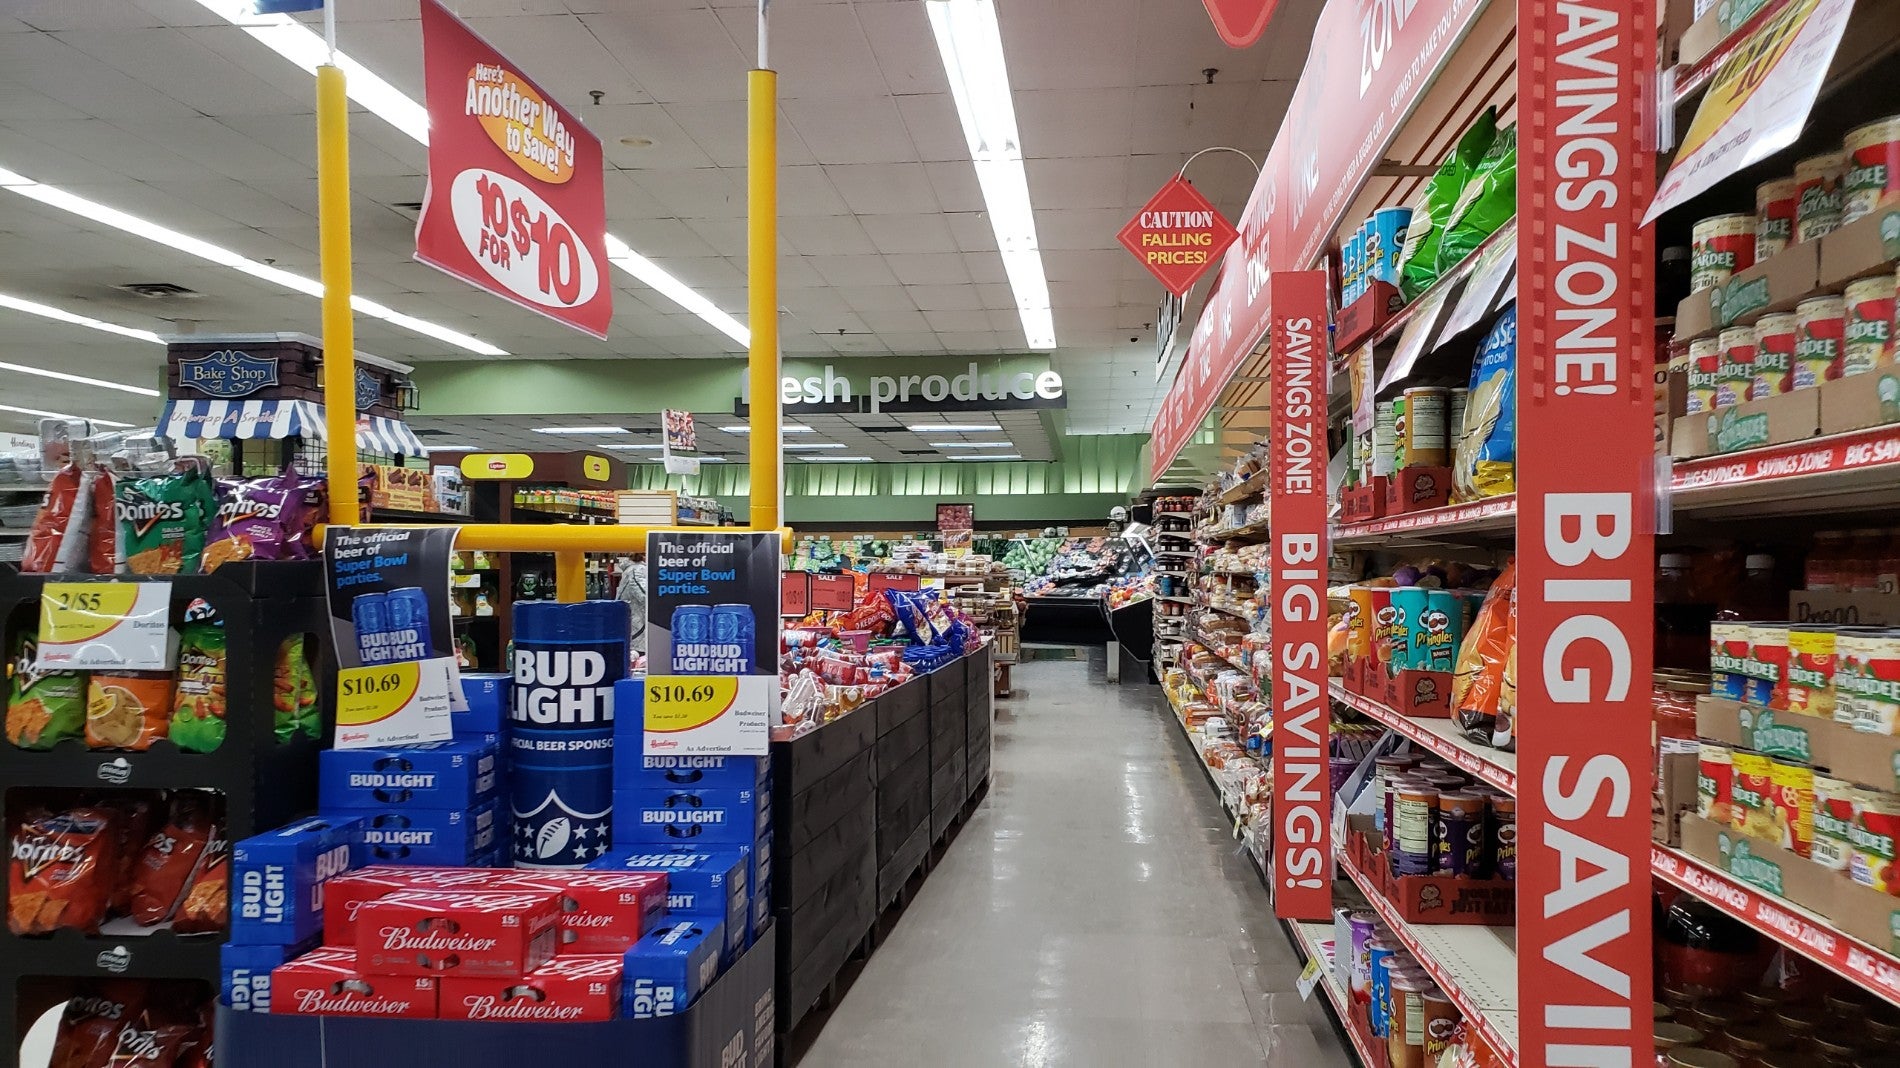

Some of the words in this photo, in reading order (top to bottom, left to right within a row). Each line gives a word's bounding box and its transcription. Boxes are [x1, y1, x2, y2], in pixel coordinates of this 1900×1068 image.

[1391, 69, 1412, 113] SAVINGS
[1412, 58, 1419, 79] TO
[1420, 30, 1438, 68] MAKE
[1438, 8, 1452, 41] YOU
[476, 63, 504, 83] Here's
[1555, 0, 1619, 211] AVINGS
[466, 78, 540, 128] Another
[542, 100, 575, 168] Way
[506, 122, 520, 153] to
[523, 128, 560, 176] Save!
[1140, 211, 1213, 228] CAUTION
[476, 174, 508, 238] 10
[510, 197, 580, 304] $10
[480, 228, 510, 270] FOR
[1142, 233, 1212, 246] FALLING
[1148, 251, 1208, 264] PRICES!
[1555, 222, 1618, 396] ZONE!
[194, 366, 226, 380] Bake
[231, 366, 266, 384] Shop
[1286, 317, 1312, 418] SAVINGS
[742, 365, 850, 404] esh
[870, 362, 1064, 414] produce
[224, 410, 238, 424] A
[240, 410, 281, 424] Smile!
[1286, 422, 1312, 495] ZONE!
[1844, 443, 1872, 466] BIG
[1756, 456, 1798, 476] SAVINGS
[219, 500, 281, 518] oritos
[336, 536, 360, 546] The
[362, 532, 410, 544] official
[658, 542, 684, 554] The
[687, 542, 734, 554] official
[334, 548, 363, 560] beer
[366, 544, 381, 556] of
[658, 556, 690, 568] beer
[692, 556, 707, 568] of
[335, 560, 372, 573] Super
[374, 554, 408, 568] Bowl
[336, 572, 384, 589] parties.
[658, 569, 698, 583] Super
[701, 568, 736, 581] Bowl
[1281, 533, 1320, 622] BIG
[658, 583, 710, 596] parties.
[1543, 492, 1632, 703] BIG
[360, 633, 388, 648] BUD
[1376, 624, 1392, 642] Prin
[676, 644, 710, 658] BUD
[710, 644, 742, 658] BUD
[515, 650, 606, 686] BUD
[343, 674, 400, 696] $10.69
[650, 686, 714, 703] $10.69
[511, 685, 614, 724] LIGHT
[386, 733, 420, 742] Advertised
[536, 741, 566, 750] BEER
[568, 738, 614, 750] SPONSO
[452, 755, 463, 763] 15
[644, 756, 678, 768] BUD
[679, 756, 724, 768] LIGHT
[1282, 642, 1323, 890] SAVINGS!
[350, 774, 386, 788] BUD
[387, 774, 434, 788] LIGHT
[740, 791, 750, 799] 15
[450, 812, 461, 820] 15
[643, 811, 678, 823] BUD
[678, 811, 724, 824] LIGHT
[385, 832, 433, 844] LIGHT
[316, 844, 350, 880] BUD
[711, 874, 722, 883] 15
[242, 871, 262, 918] BUD
[265, 865, 284, 923] LIGHT
[1543, 754, 1632, 1068] SAVI
[1756, 902, 1800, 940] SAVINGS
[379, 926, 496, 951] Budweiser
[1846, 946, 1876, 978] BIG
[231, 969, 250, 1011] LIG
[252, 974, 270, 1014] BU
[294, 988, 410, 1014] Budweiser
[634, 978, 654, 1019] LIG
[655, 986, 674, 1017] BU
[463, 994, 584, 1020] Budweiser
